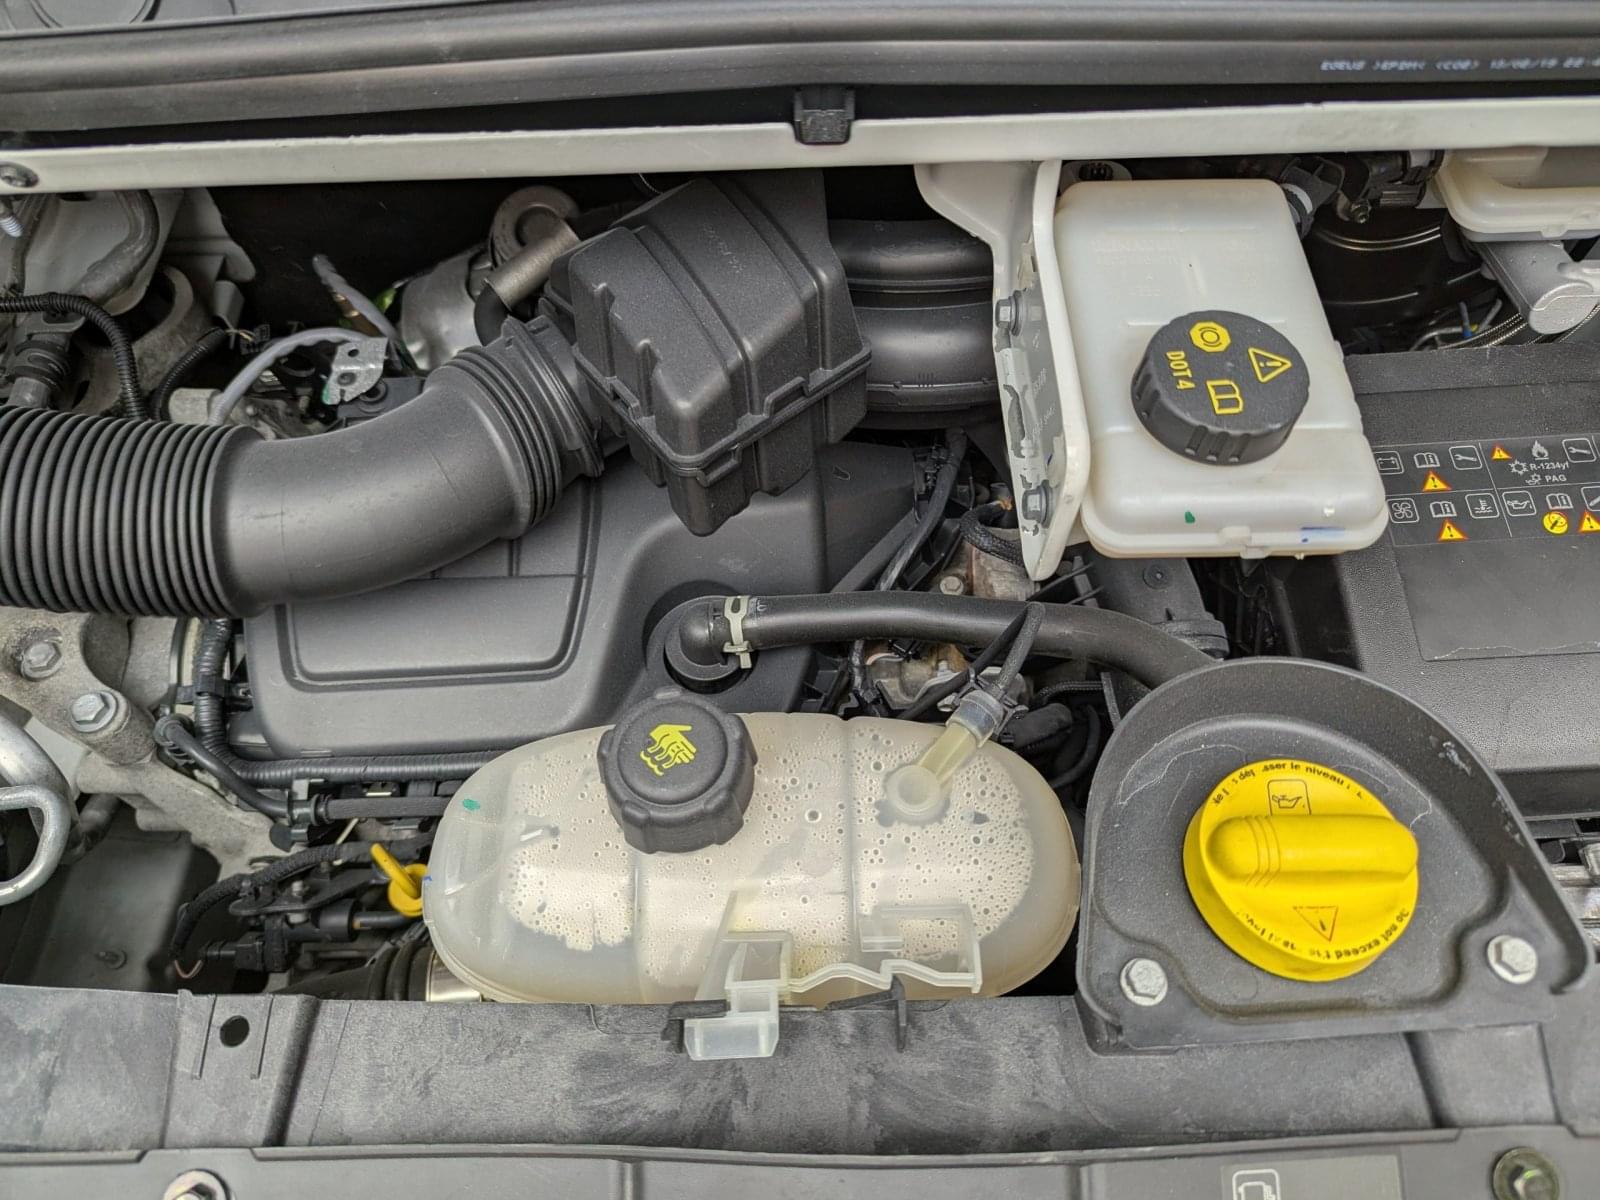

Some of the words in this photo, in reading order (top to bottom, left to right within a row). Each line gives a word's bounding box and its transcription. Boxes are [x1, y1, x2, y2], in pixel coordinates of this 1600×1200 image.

[1166, 351, 1192, 378] DOT
[1176, 379, 1196, 390] 4
[1529, 461, 1570, 471] R-1234yf
[1545, 474, 1567, 482] PAG
[1290, 761, 1301, 770] le
[1305, 766, 1345, 785] niveau
[1380, 923, 1398, 941] not
[1334, 938, 1381, 960] exceed
